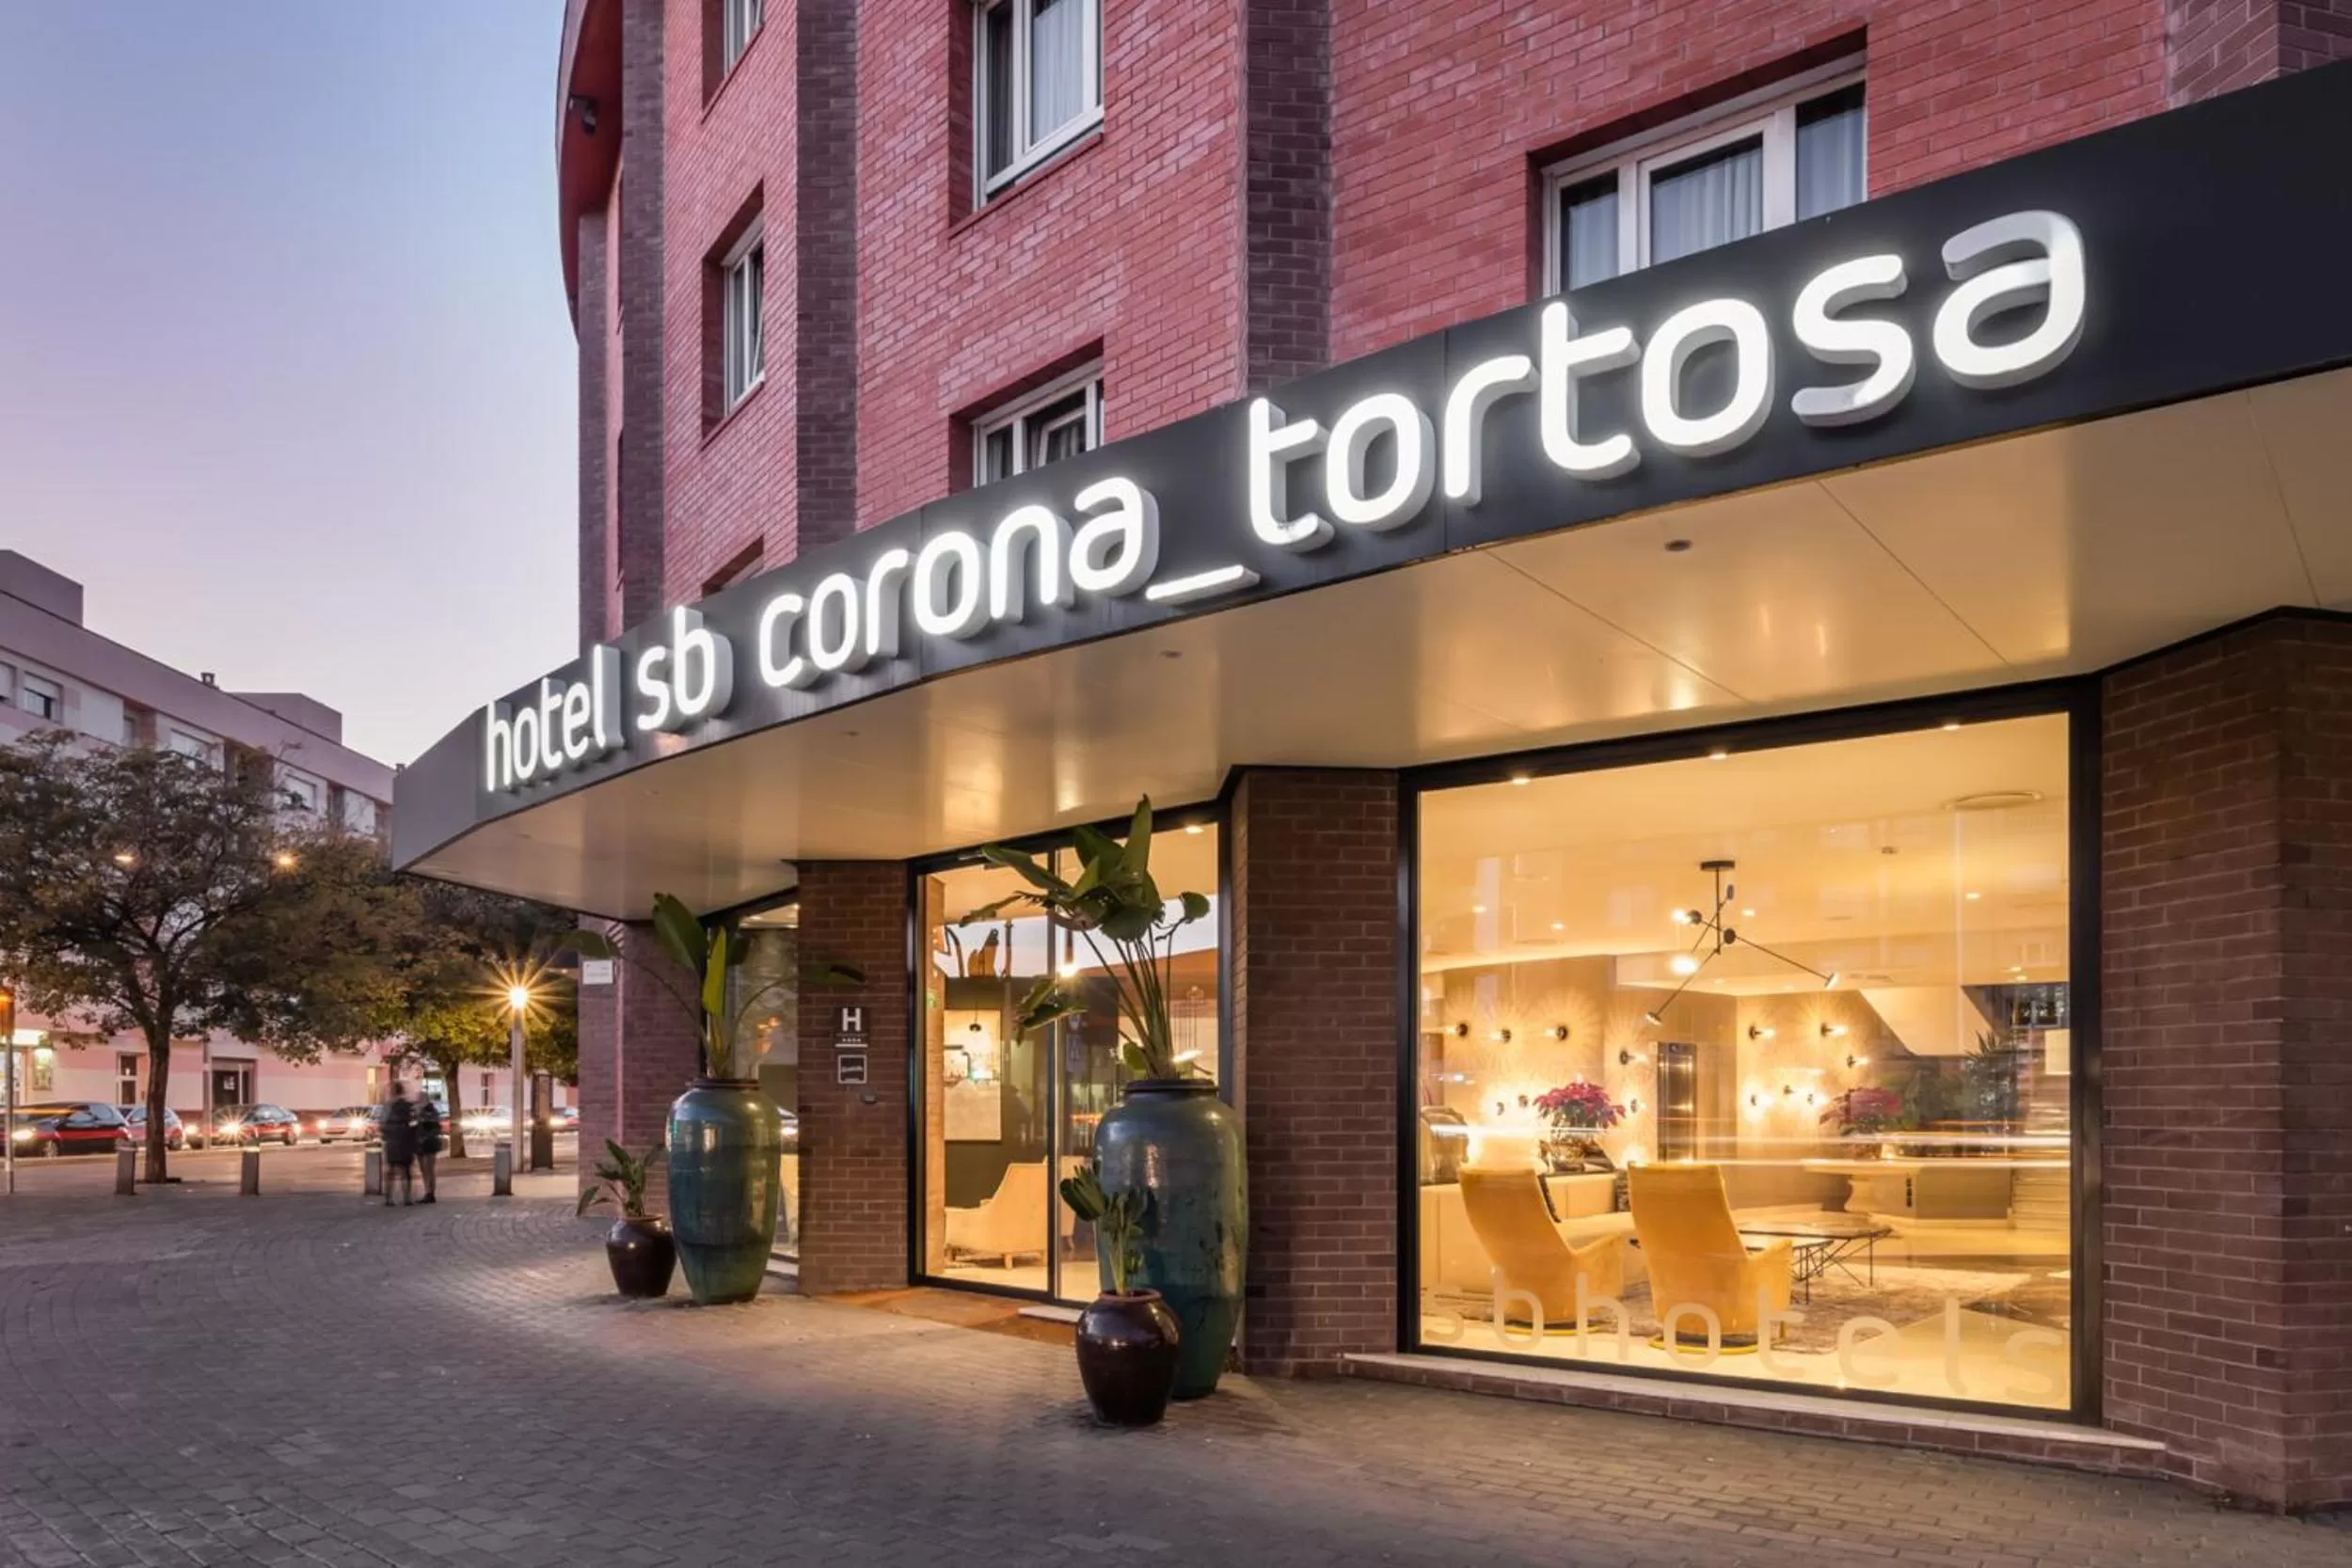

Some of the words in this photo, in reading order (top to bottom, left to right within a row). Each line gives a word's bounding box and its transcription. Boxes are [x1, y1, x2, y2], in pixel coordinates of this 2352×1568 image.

[484, 643, 618, 792] hotel
[636, 605, 730, 732] sb
[842, 1007, 862, 1032] H
